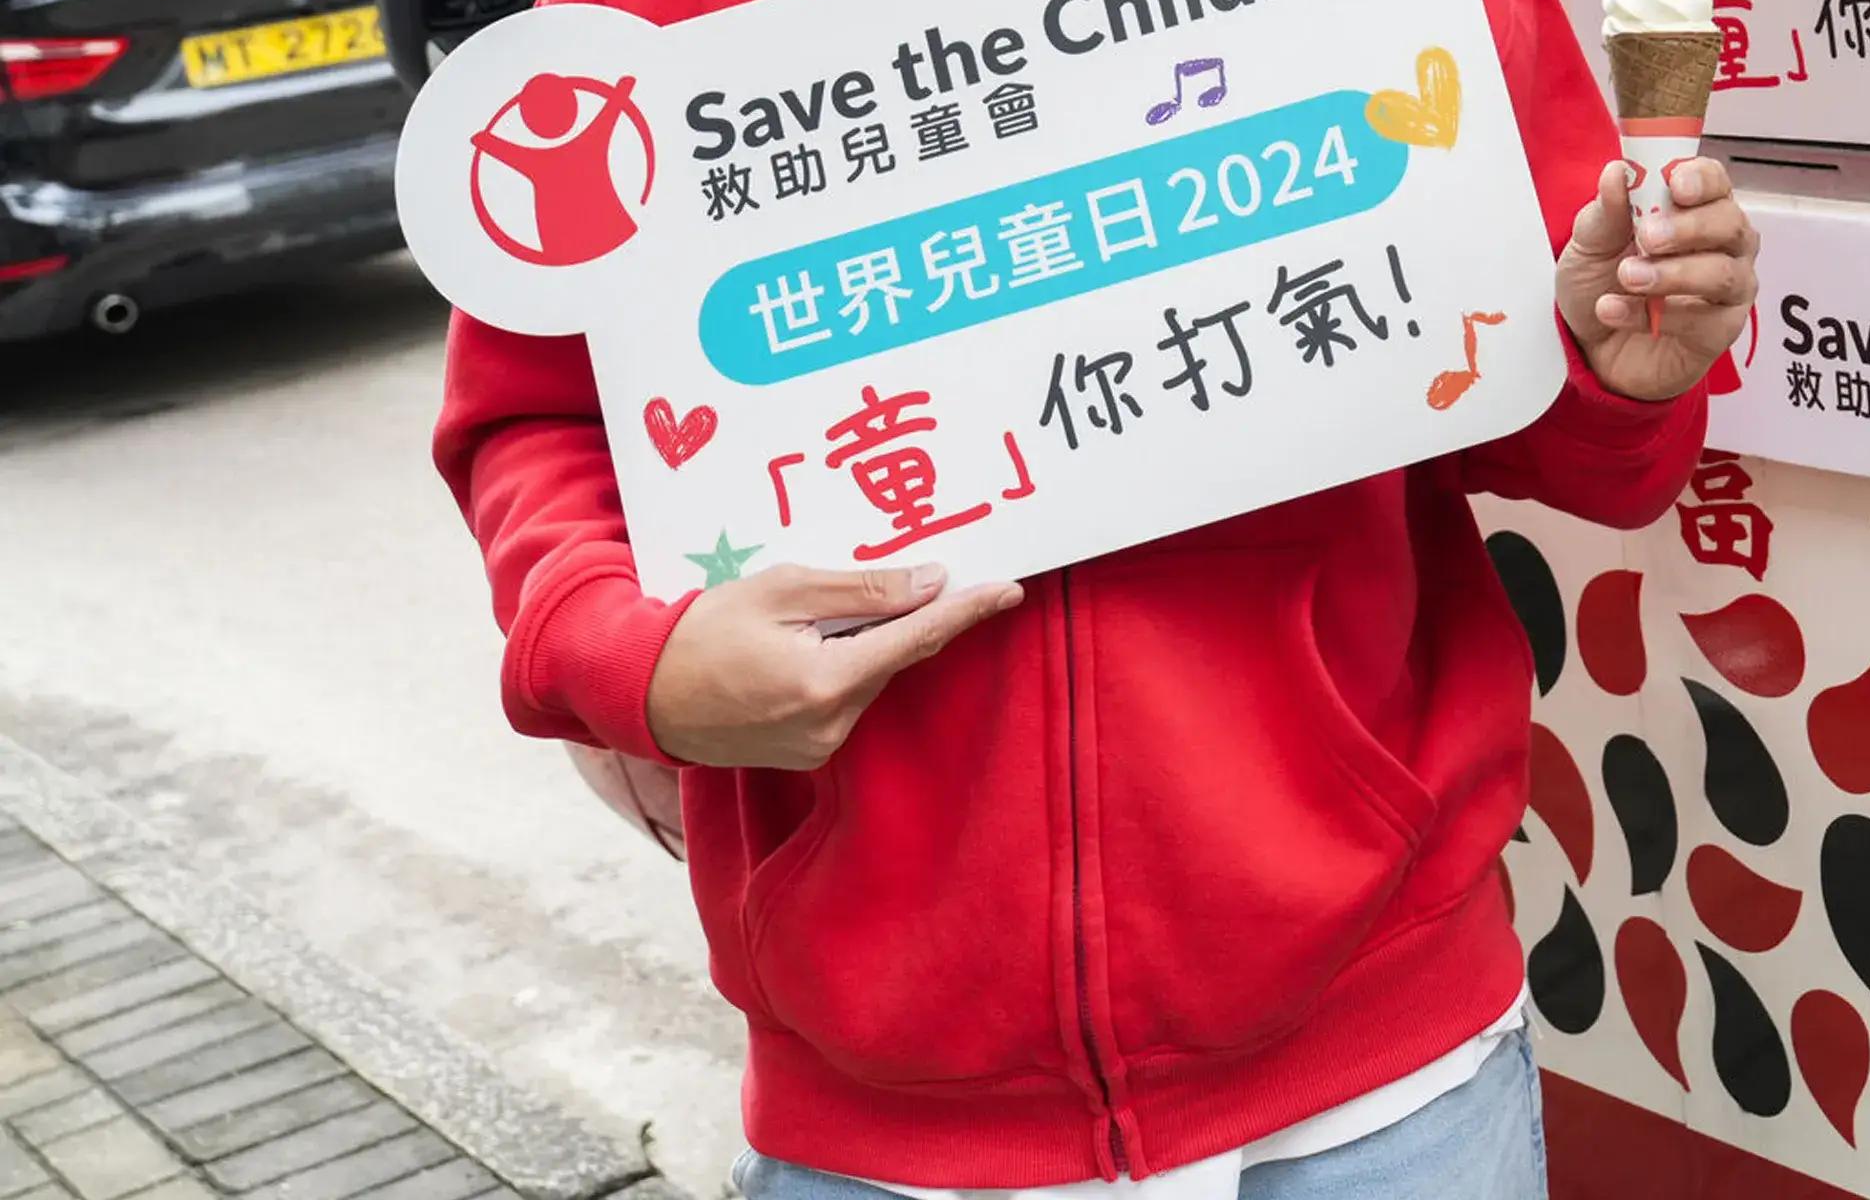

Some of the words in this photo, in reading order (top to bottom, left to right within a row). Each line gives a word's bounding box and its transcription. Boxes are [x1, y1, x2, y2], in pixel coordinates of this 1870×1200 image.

[684, 65, 877, 161] Save
[893, 25, 1029, 104] the
[700, 80, 1041, 222] 救助兒童會
[749, 123, 1360, 357] 世界兒童日2024
